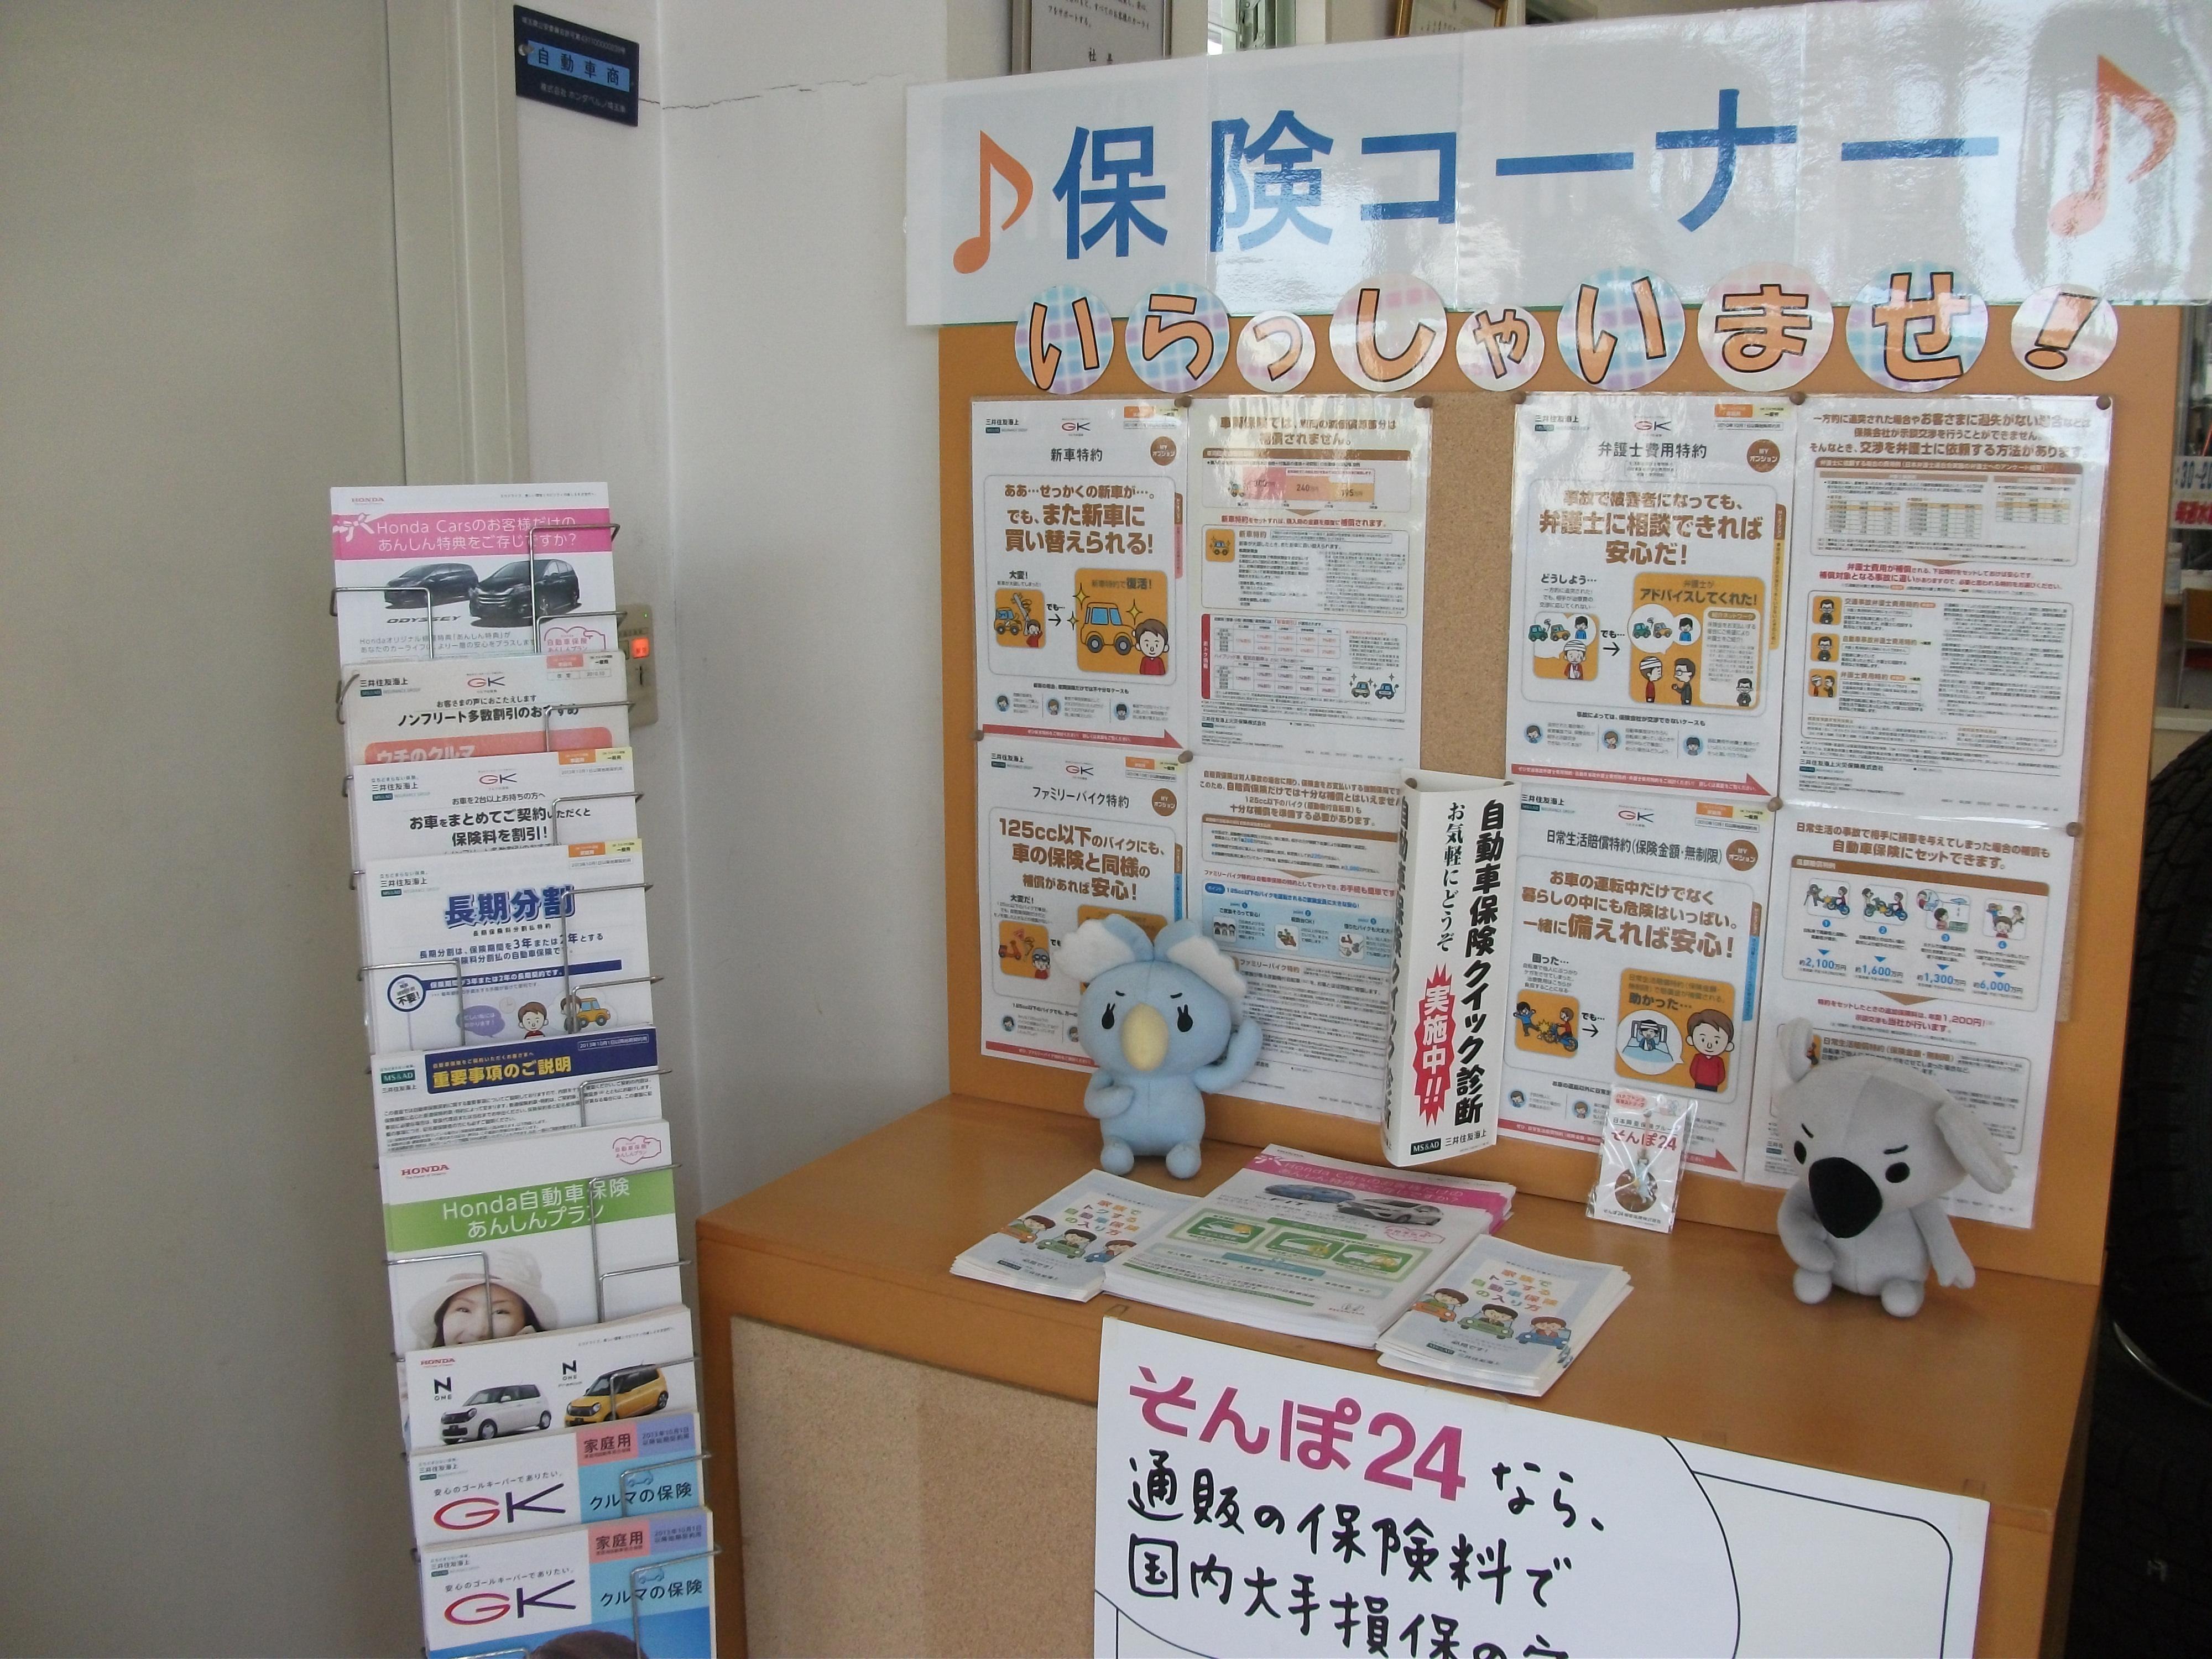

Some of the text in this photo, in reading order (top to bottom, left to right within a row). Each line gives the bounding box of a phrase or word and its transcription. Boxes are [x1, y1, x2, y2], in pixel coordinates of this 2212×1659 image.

[538, 48, 619, 86] 自動車商
[1052, 87, 2000, 260] 保険コーナー
[1029, 271, 2101, 390] いらっしゃいませ!
[1062, 422, 1091, 431] GK
[1535, 414, 1579, 423] 三井住友海上
[1634, 420, 1672, 431] GK
[1051, 448, 1103, 462] 新車特約
[1598, 442, 1708, 459] 弁護士費用特約
[1005, 484, 1155, 499] ああ…せっかくの新車が…。
[1007, 504, 1145, 527] でも、また新車に
[1539, 509, 1763, 540] 弁護士に相談できれば
[377, 520, 429, 534] Honda
[1005, 529, 1153, 554] 買い替えられる!
[1605, 540, 1688, 566] 安心だ!
[1540, 573, 1597, 585] どうしよう…
[1640, 588, 1757, 606] アドバイスしてくれた!
[387, 615, 461, 624] ODYSSEY
[1601, 629, 1625, 639] でも…
[360, 677, 408, 687] 三井住友海上
[467, 676, 505, 687] GK
[436, 695, 537, 708] お客さまの声におこたえします
[991, 753, 1024, 763] 三井住友海上
[479, 773, 517, 785] GK
[1066, 765, 1094, 776] GK
[372, 782, 418, 792] 三井住友海上
[452, 792, 545, 806] お車を2台以上お持ちの方へ
[1033, 786, 1129, 808] ファミリーバイク特約
[1521, 794, 1564, 806] 三井住友海上
[409, 807, 591, 830] お車をまとめてご契約いただくと
[1618, 810, 1654, 823] GK
[452, 828, 548, 847] 保険料を割引!
[999, 818, 1165, 855] 125cc以下のバイクにも、
[1547, 830, 1722, 864] 日常生活賠償特約(保険金額・無制限)
[1832, 839, 2006, 870] 自動車保険にセットできます。
[1012, 843, 1150, 878] 車の保険と同様の
[1728, 854, 1756, 863] オプション
[380, 878, 427, 887] 三井住友海上
[1437, 802, 1465, 952] お気軽にどうぞ
[1022, 874, 1136, 900] 補償があれば安心!
[1550, 870, 1714, 905] お車の運転中だけでなく
[445, 884, 575, 928] 長期分割
[1522, 886, 1737, 930] 暮らしの中にも危険はいっぱい。
[473, 924, 551, 937] 長期保険料分割払特約
[1524, 912, 1734, 959] 一緒に備えれば安心!
[1454, 799, 1505, 1127] 自動車保険クイック診断
[1799, 958, 1847, 972] 約2,100万円
[1855, 964, 1903, 979] 約1,600万円
[1917, 973, 1966, 987] 約1,300万円
[1973, 981, 2023, 995] 約6,000万円
[1629, 992, 1692, 1010] 助かった…
[1581, 1012, 1605, 1021] でも…
[384, 1072, 414, 1081] MS&AD
[432, 1056, 572, 1089] 重要事項のご説明
[382, 1084, 417, 1093] 三井住友海上
[1413, 1129, 1487, 1152] MS&AD 三井住友海上
[1611, 1130, 1677, 1151] そんぽ24
[401, 1164, 450, 1176] HONDA
[1284, 1162, 1331, 1176] Honda
[443, 1177, 629, 1220] Honda自動車保険
[468, 1204, 604, 1239] あんしんプラン
[562, 1360, 577, 1374] N
[434, 1377, 452, 1395] N
[584, 1433, 631, 1453] 家庭用
[1129, 1365, 1605, 1532] そんぽ24 なら、
[419, 1464, 458, 1473] 三井住友海上
[434, 1471, 562, 1496] 安心のゴールキーパーでありたい。
[589, 1482, 692, 1511] クルマの保険
[434, 1483, 566, 1530] GK
[1128, 1448, 1573, 1608] 通販の保険料で
[595, 1530, 643, 1550] 家庭用
[431, 1559, 469, 1570] 三井住友海上
[445, 1568, 574, 1592] 安心のゴールキーパーでありたい。
[444, 1579, 576, 1625] GK
[600, 1579, 703, 1608] クルマの保険
